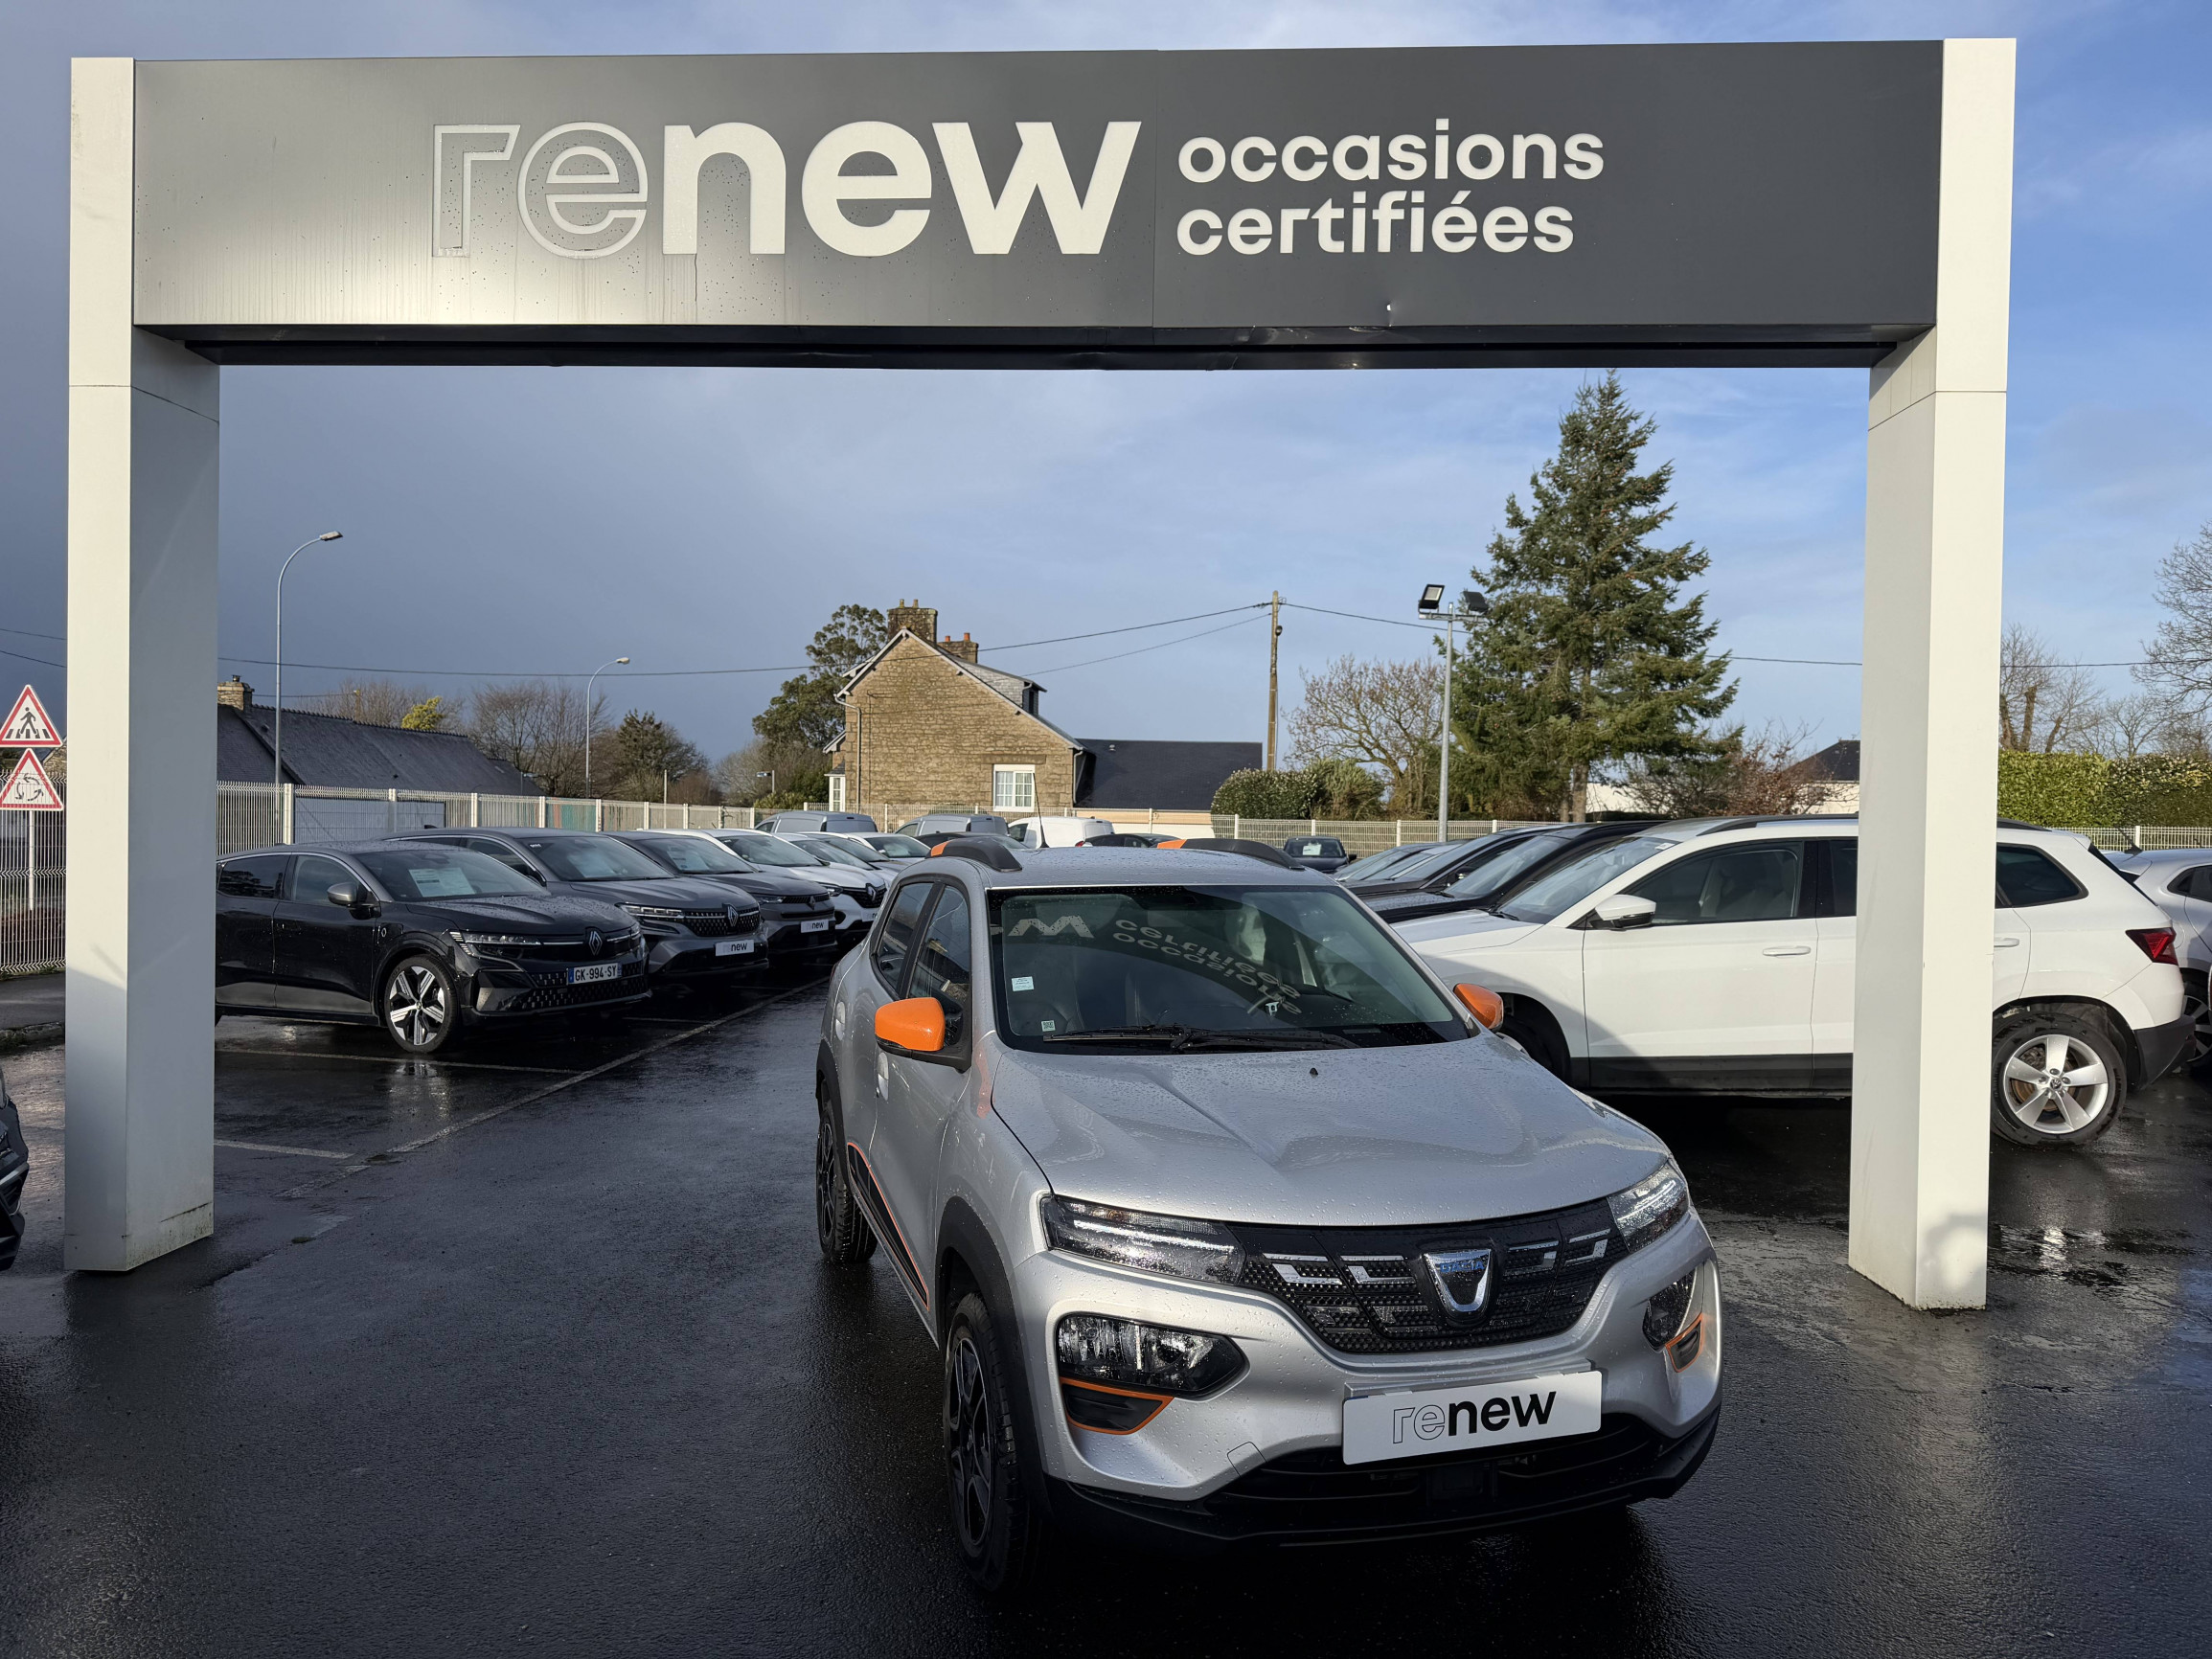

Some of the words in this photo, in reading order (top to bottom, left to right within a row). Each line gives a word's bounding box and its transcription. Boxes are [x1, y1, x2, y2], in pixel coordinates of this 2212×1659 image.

[1177, 118, 1605, 184] occasions
[432, 121, 1142, 260] renew
[1176, 191, 1574, 256] certifiées
[575, 965, 617, 982] GK-994-SY
[1393, 1391, 1557, 1444] renew
